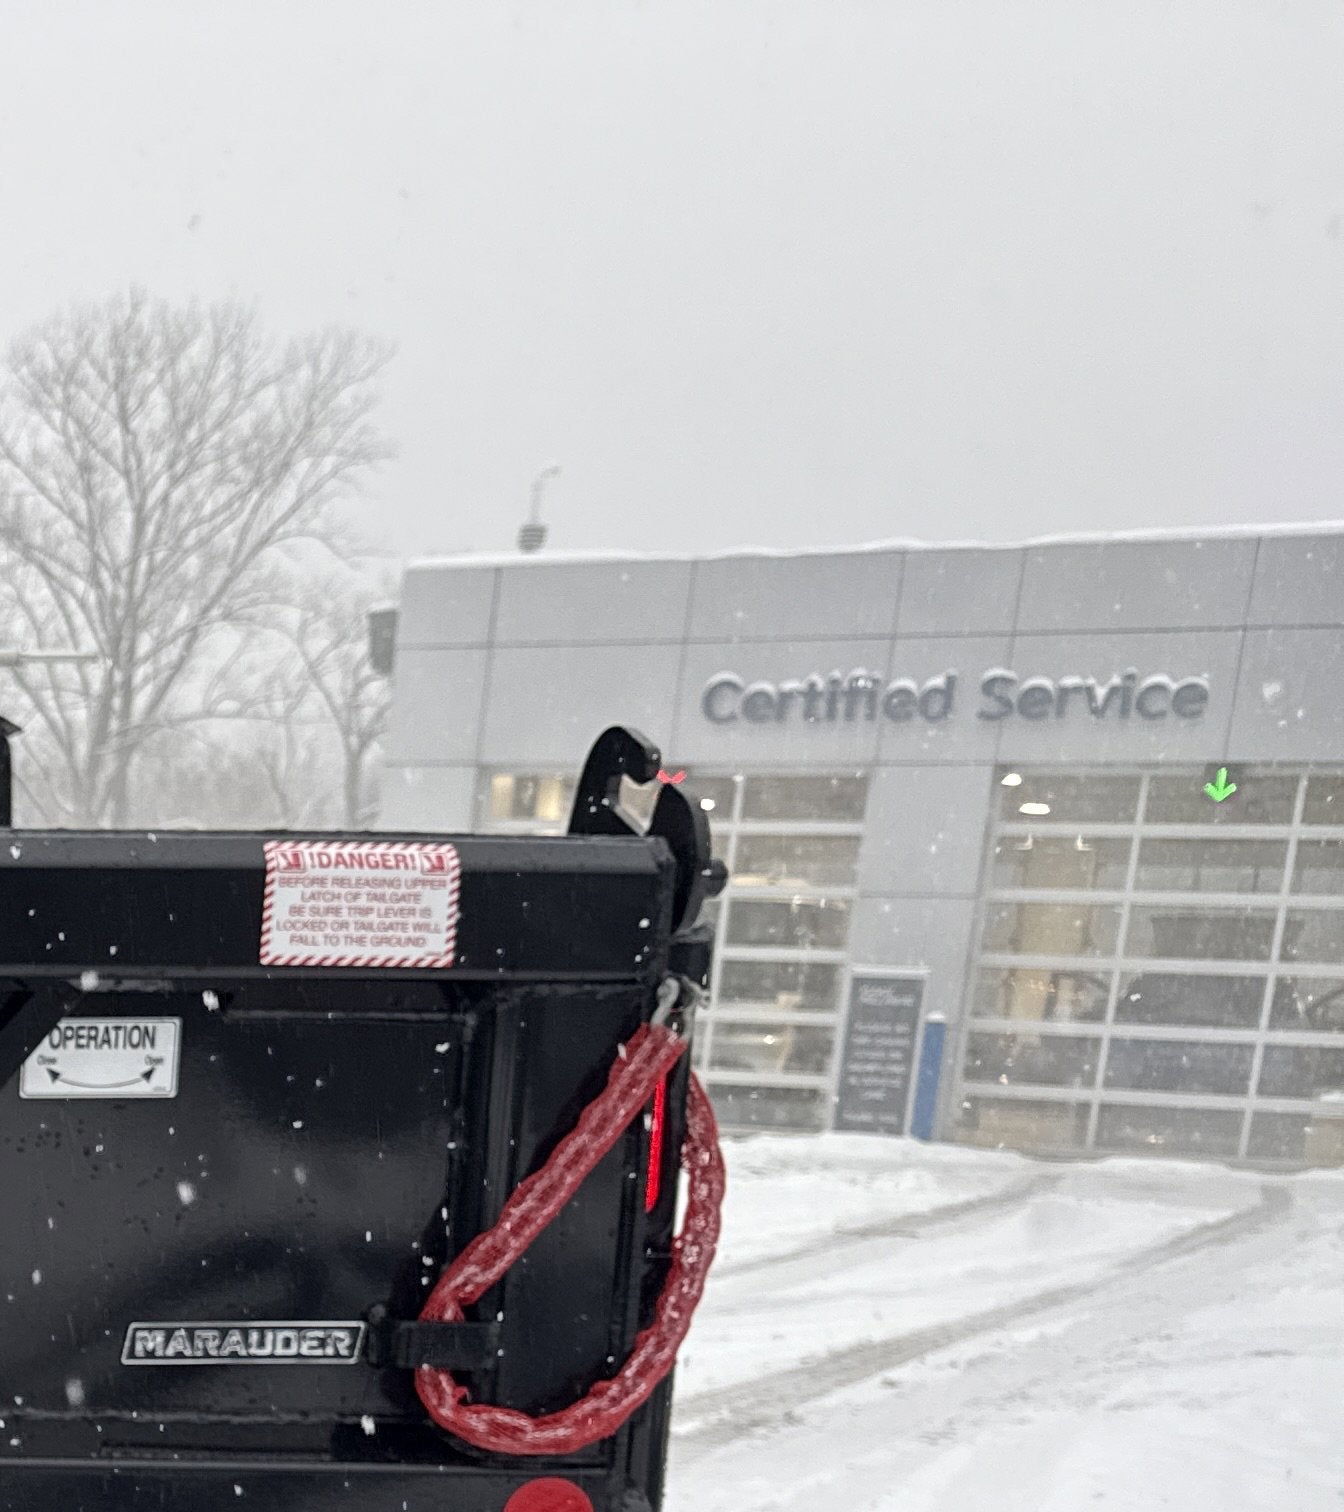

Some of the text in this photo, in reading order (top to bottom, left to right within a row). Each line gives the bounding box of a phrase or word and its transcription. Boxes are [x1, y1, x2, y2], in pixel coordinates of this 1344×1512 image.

[701, 668, 1210, 723] Certified Service
[278, 876, 447, 890] BEFORE RELEASING UPPER
[300, 890, 422, 905] LATCH OF TAILGATE
[288, 905, 432, 919] BE SURE TRIP LEVER IS
[276, 919, 441, 934] LOCKED OR TAILGATE WILL
[289, 935, 427, 949] FALL TO THE GROUND
[48, 1025, 157, 1050] OPERATION
[133, 1329, 353, 1357] MARAUDER
